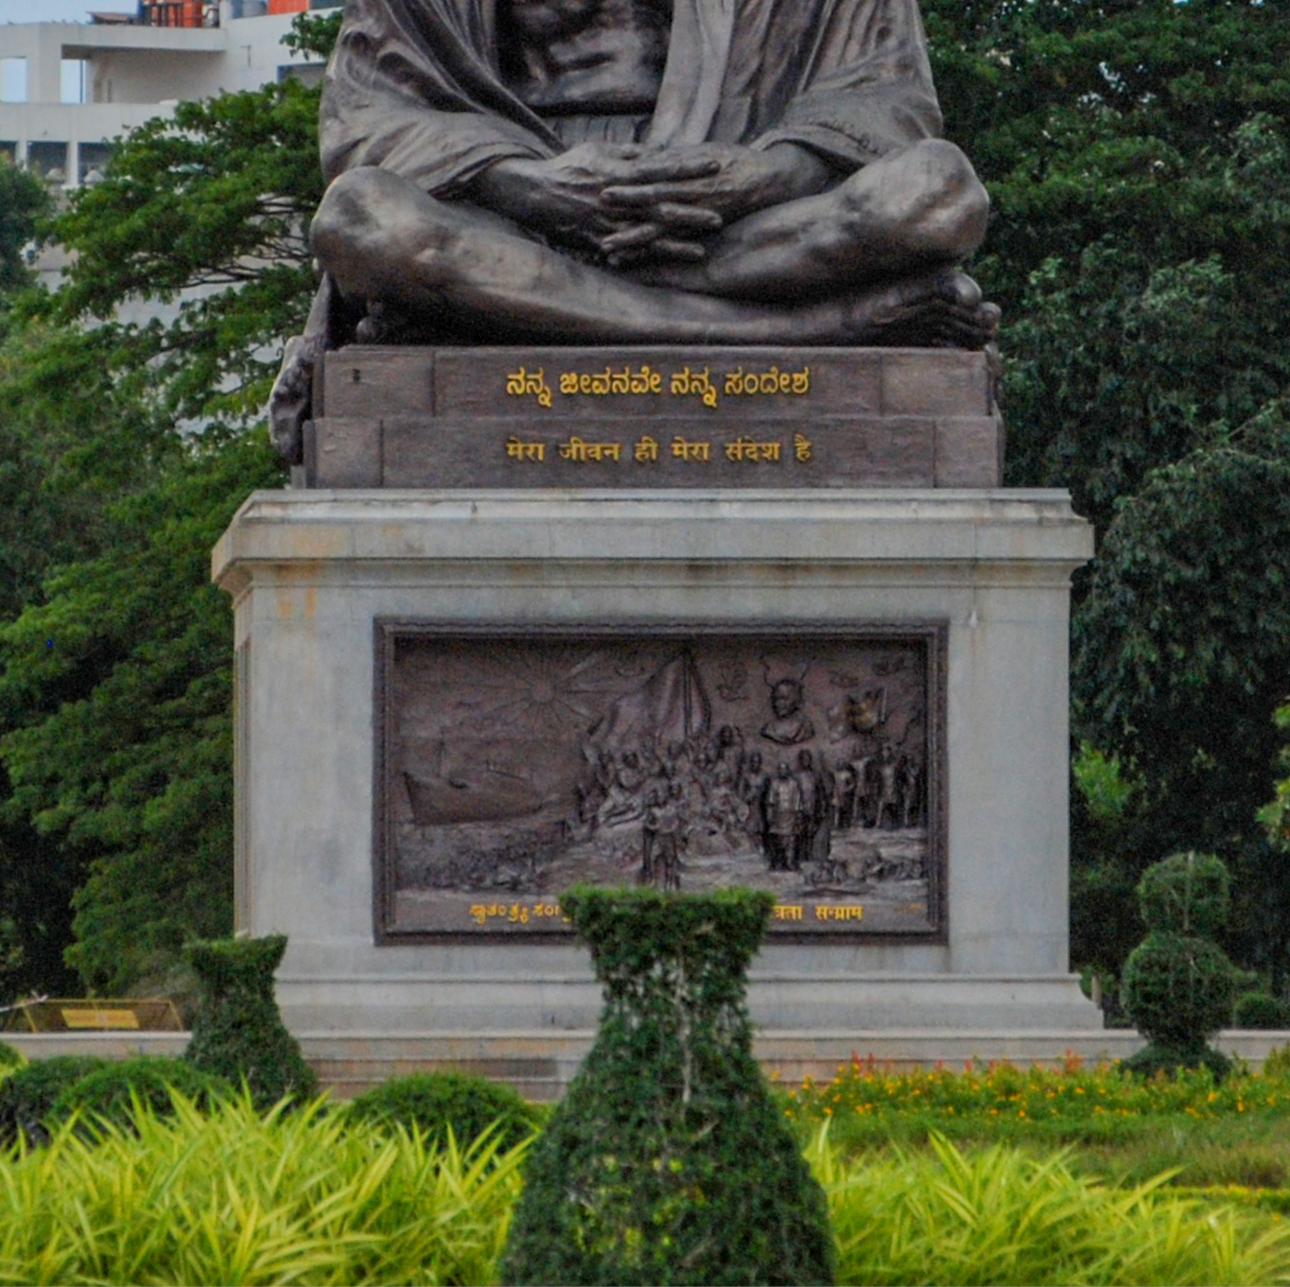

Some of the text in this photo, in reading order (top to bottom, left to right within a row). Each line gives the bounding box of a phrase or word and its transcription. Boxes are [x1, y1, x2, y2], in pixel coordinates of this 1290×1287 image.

[506, 365, 809, 408] ನನ್ನ ಜೀವನವೇ ನನ್ನ ಸಂದೇಶ
[506, 433, 812, 462] मेरा जीवन ही मेरा संदेश है
